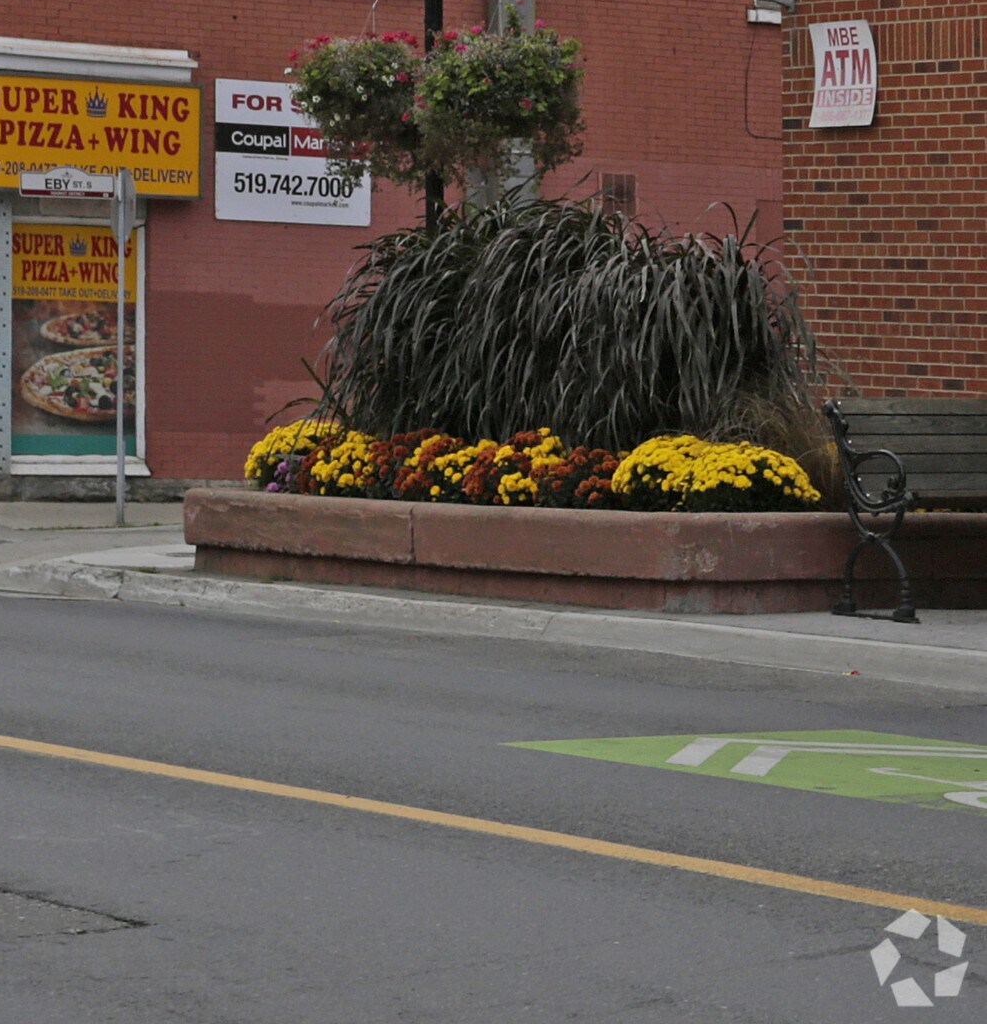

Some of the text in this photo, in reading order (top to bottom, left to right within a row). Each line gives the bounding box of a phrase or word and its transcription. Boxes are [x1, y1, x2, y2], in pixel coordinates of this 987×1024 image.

[827, 27, 859, 46] MBE
[821, 48, 871, 87] ATM
[232, 94, 282, 112] FOR
[817, 89, 871, 106] INSIDE
[118, 93, 190, 122] KING
[231, 131, 286, 150] Coupal
[45, 178, 70, 189] EBY
[87, 181, 92, 189] S
[234, 172, 353, 198] 519.742.7000
[12, 233, 64, 256] SUPER
[59, 287, 76, 296] TAKE
